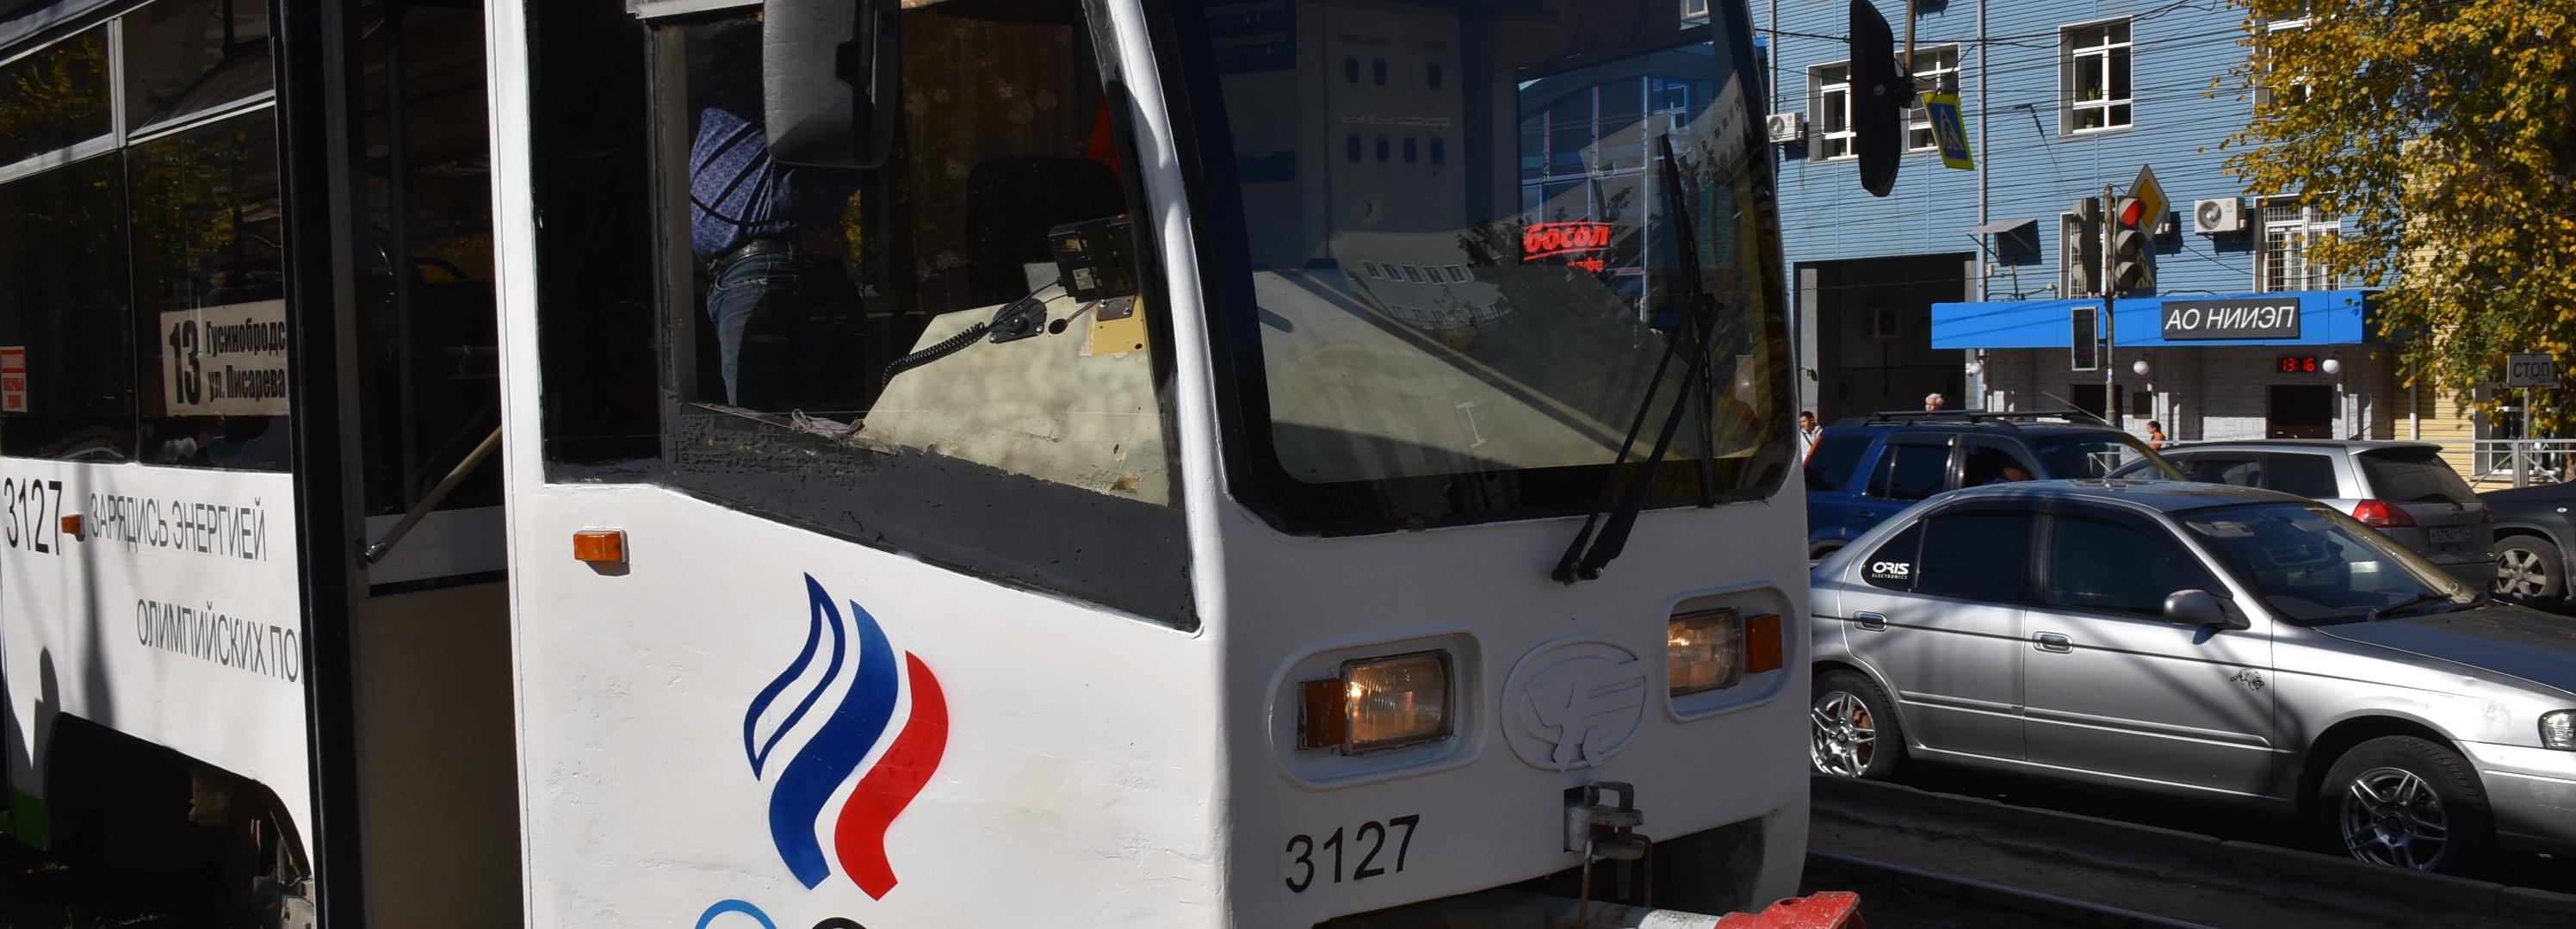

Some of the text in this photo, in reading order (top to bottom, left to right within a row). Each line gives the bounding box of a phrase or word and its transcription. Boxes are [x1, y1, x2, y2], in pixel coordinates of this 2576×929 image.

[2164, 306, 2294, 331] АО НИИЭП
[169, 319, 201, 406] 13
[207, 365, 286, 402] ул. Писарева
[2282, 357, 2315, 372] 13:16
[2513, 362, 2550, 378] СТОП
[3, 477, 63, 556] 3127
[90, 492, 267, 561] ЗАРЯДИСЬ ЭНЕРГИЕЙ
[1873, 561, 1910, 575] ORIS
[137, 598, 304, 684] ОЛИМПИЙСКИХ ПО
[1285, 814, 1420, 893] 3127
